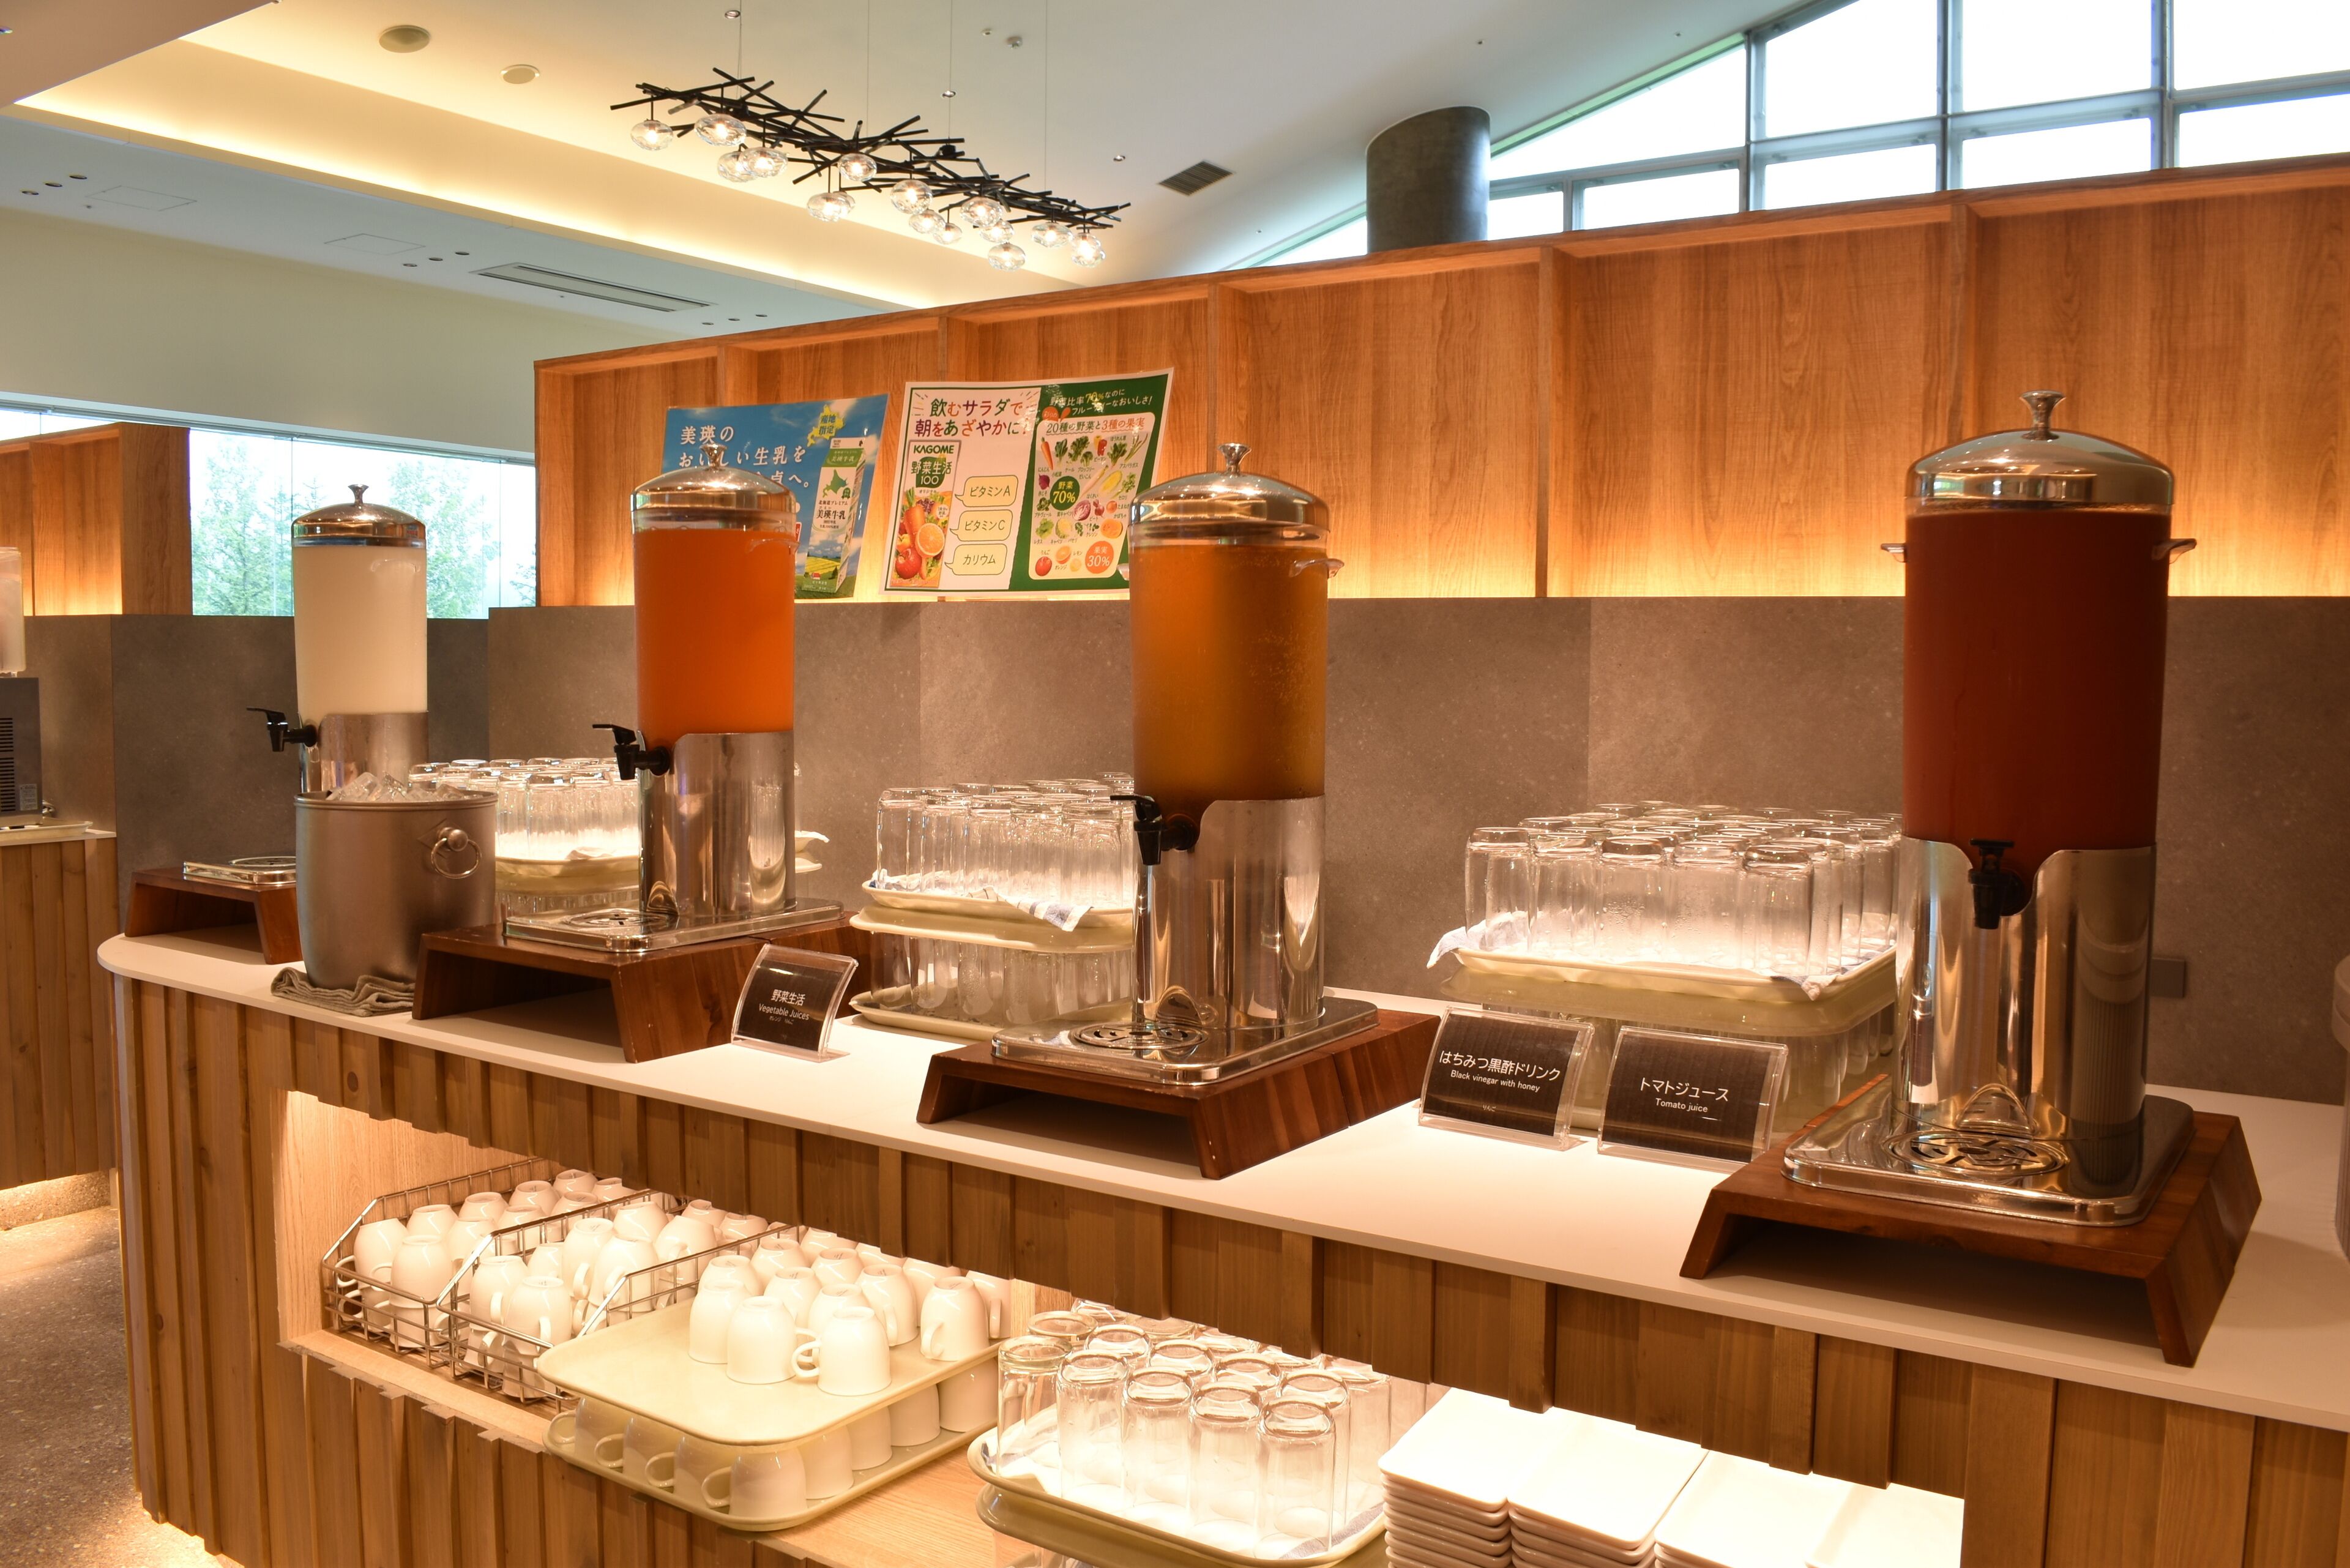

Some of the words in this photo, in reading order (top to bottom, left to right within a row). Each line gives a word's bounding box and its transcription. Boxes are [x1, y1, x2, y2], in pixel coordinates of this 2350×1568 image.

[929, 398, 1023, 417] 飲むサラダで
[1072, 395, 1153, 416] フルーィーなおいしさ!
[821, 413, 836, 423] 産地
[680, 425, 734, 445] 美瑛の
[818, 425, 834, 435] 指定
[913, 445, 955, 454] KAGOME
[911, 461, 952, 475] 野菜生活
[920, 476, 939, 485] 100
[1058, 481, 1074, 490] 野菜
[970, 485, 1010, 498] ビタミンA
[1053, 491, 1075, 504] 70%
[816, 509, 846, 520] 美瑛牛乳
[964, 520, 1005, 531] ビタミンC
[963, 554, 996, 566] カリウム
[1087, 555, 1110, 567] 30%
[770, 989, 806, 1006] 野菜生活
[759, 1004, 789, 1016] Vegetable
[789, 1009, 810, 1020] Juices
[1439, 1050, 1561, 1081] はちみつ黒酢ドリンク
[1450, 1069, 1471, 1080] Black
[1472, 1073, 1499, 1085] vinegar
[1500, 1079, 1515, 1088] with
[1518, 1081, 1541, 1092] honey
[1641, 1077, 1729, 1102] トマトジュース
[1655, 1097, 1686, 1110] Tomato
[1687, 1102, 1708, 1113] juice
